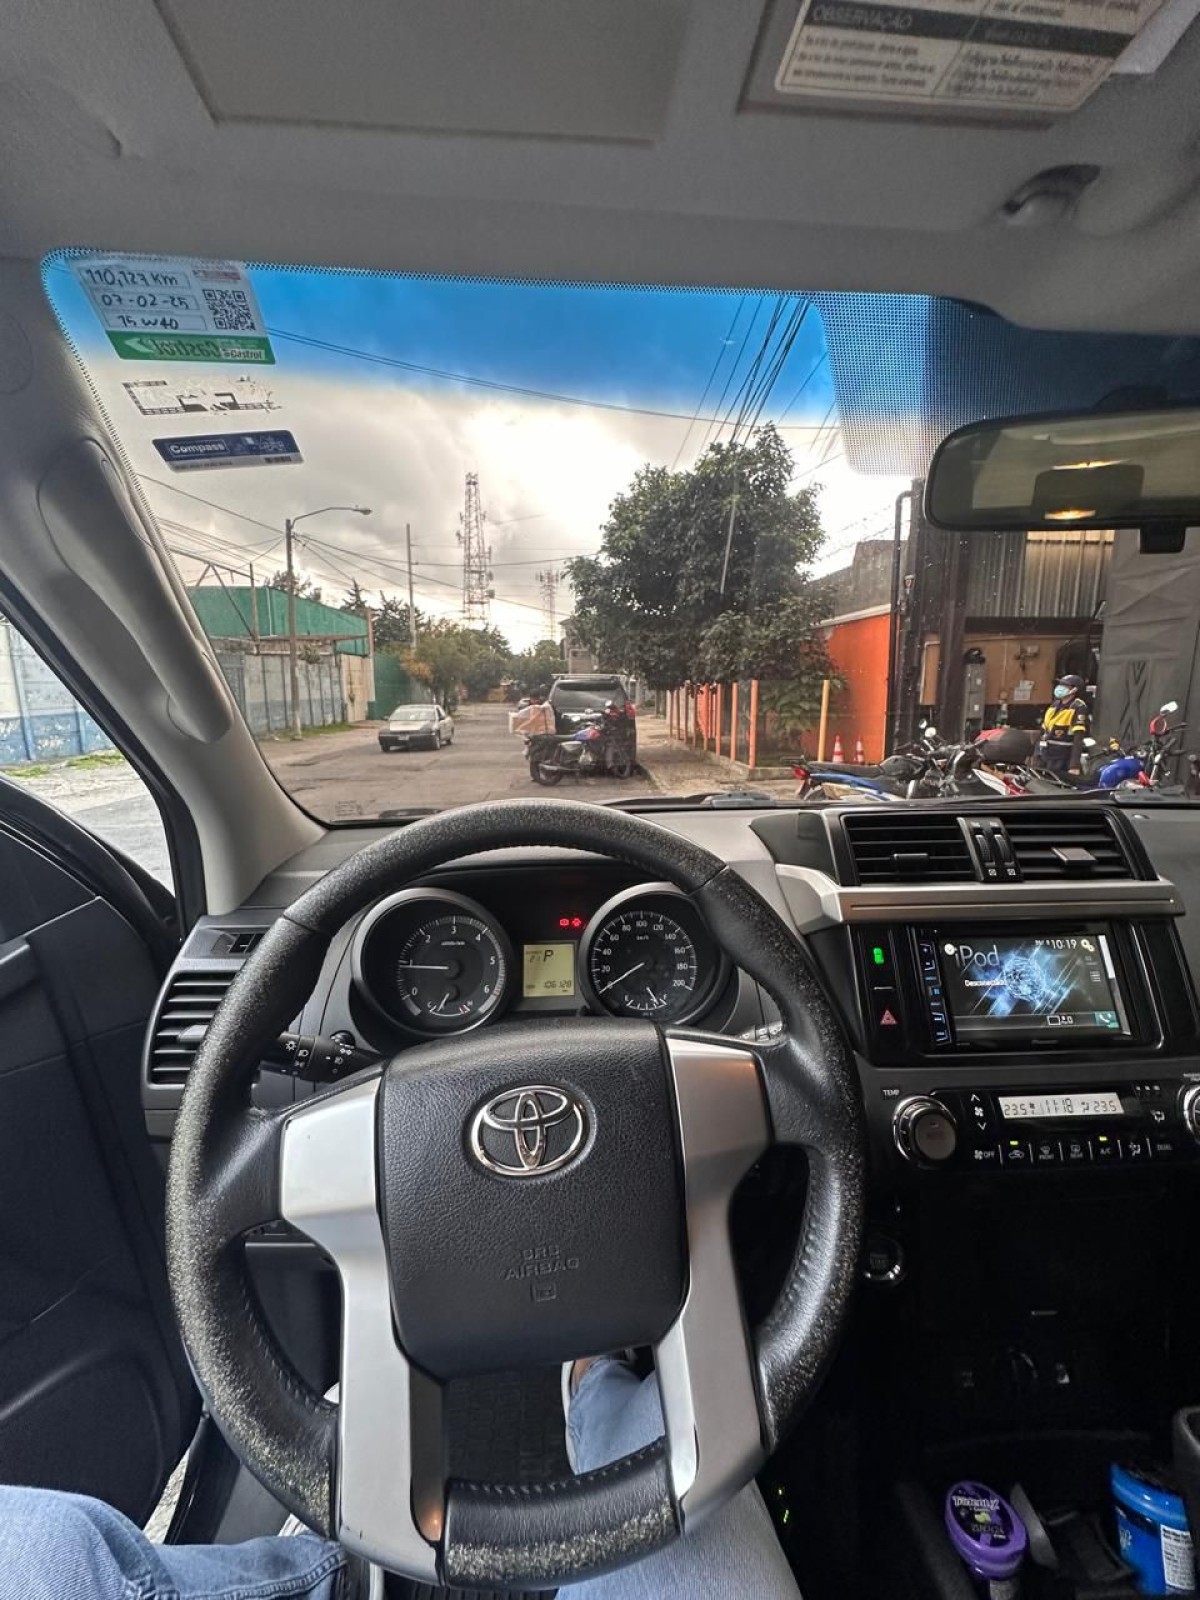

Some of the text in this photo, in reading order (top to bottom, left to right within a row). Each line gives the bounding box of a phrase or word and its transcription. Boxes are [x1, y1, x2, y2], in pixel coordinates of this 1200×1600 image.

[169, 442, 225, 455] Compass
[1050, 939, 1077, 950] 10:19
[543, 949, 554, 962] P
[955, 944, 1000, 967] iPod
